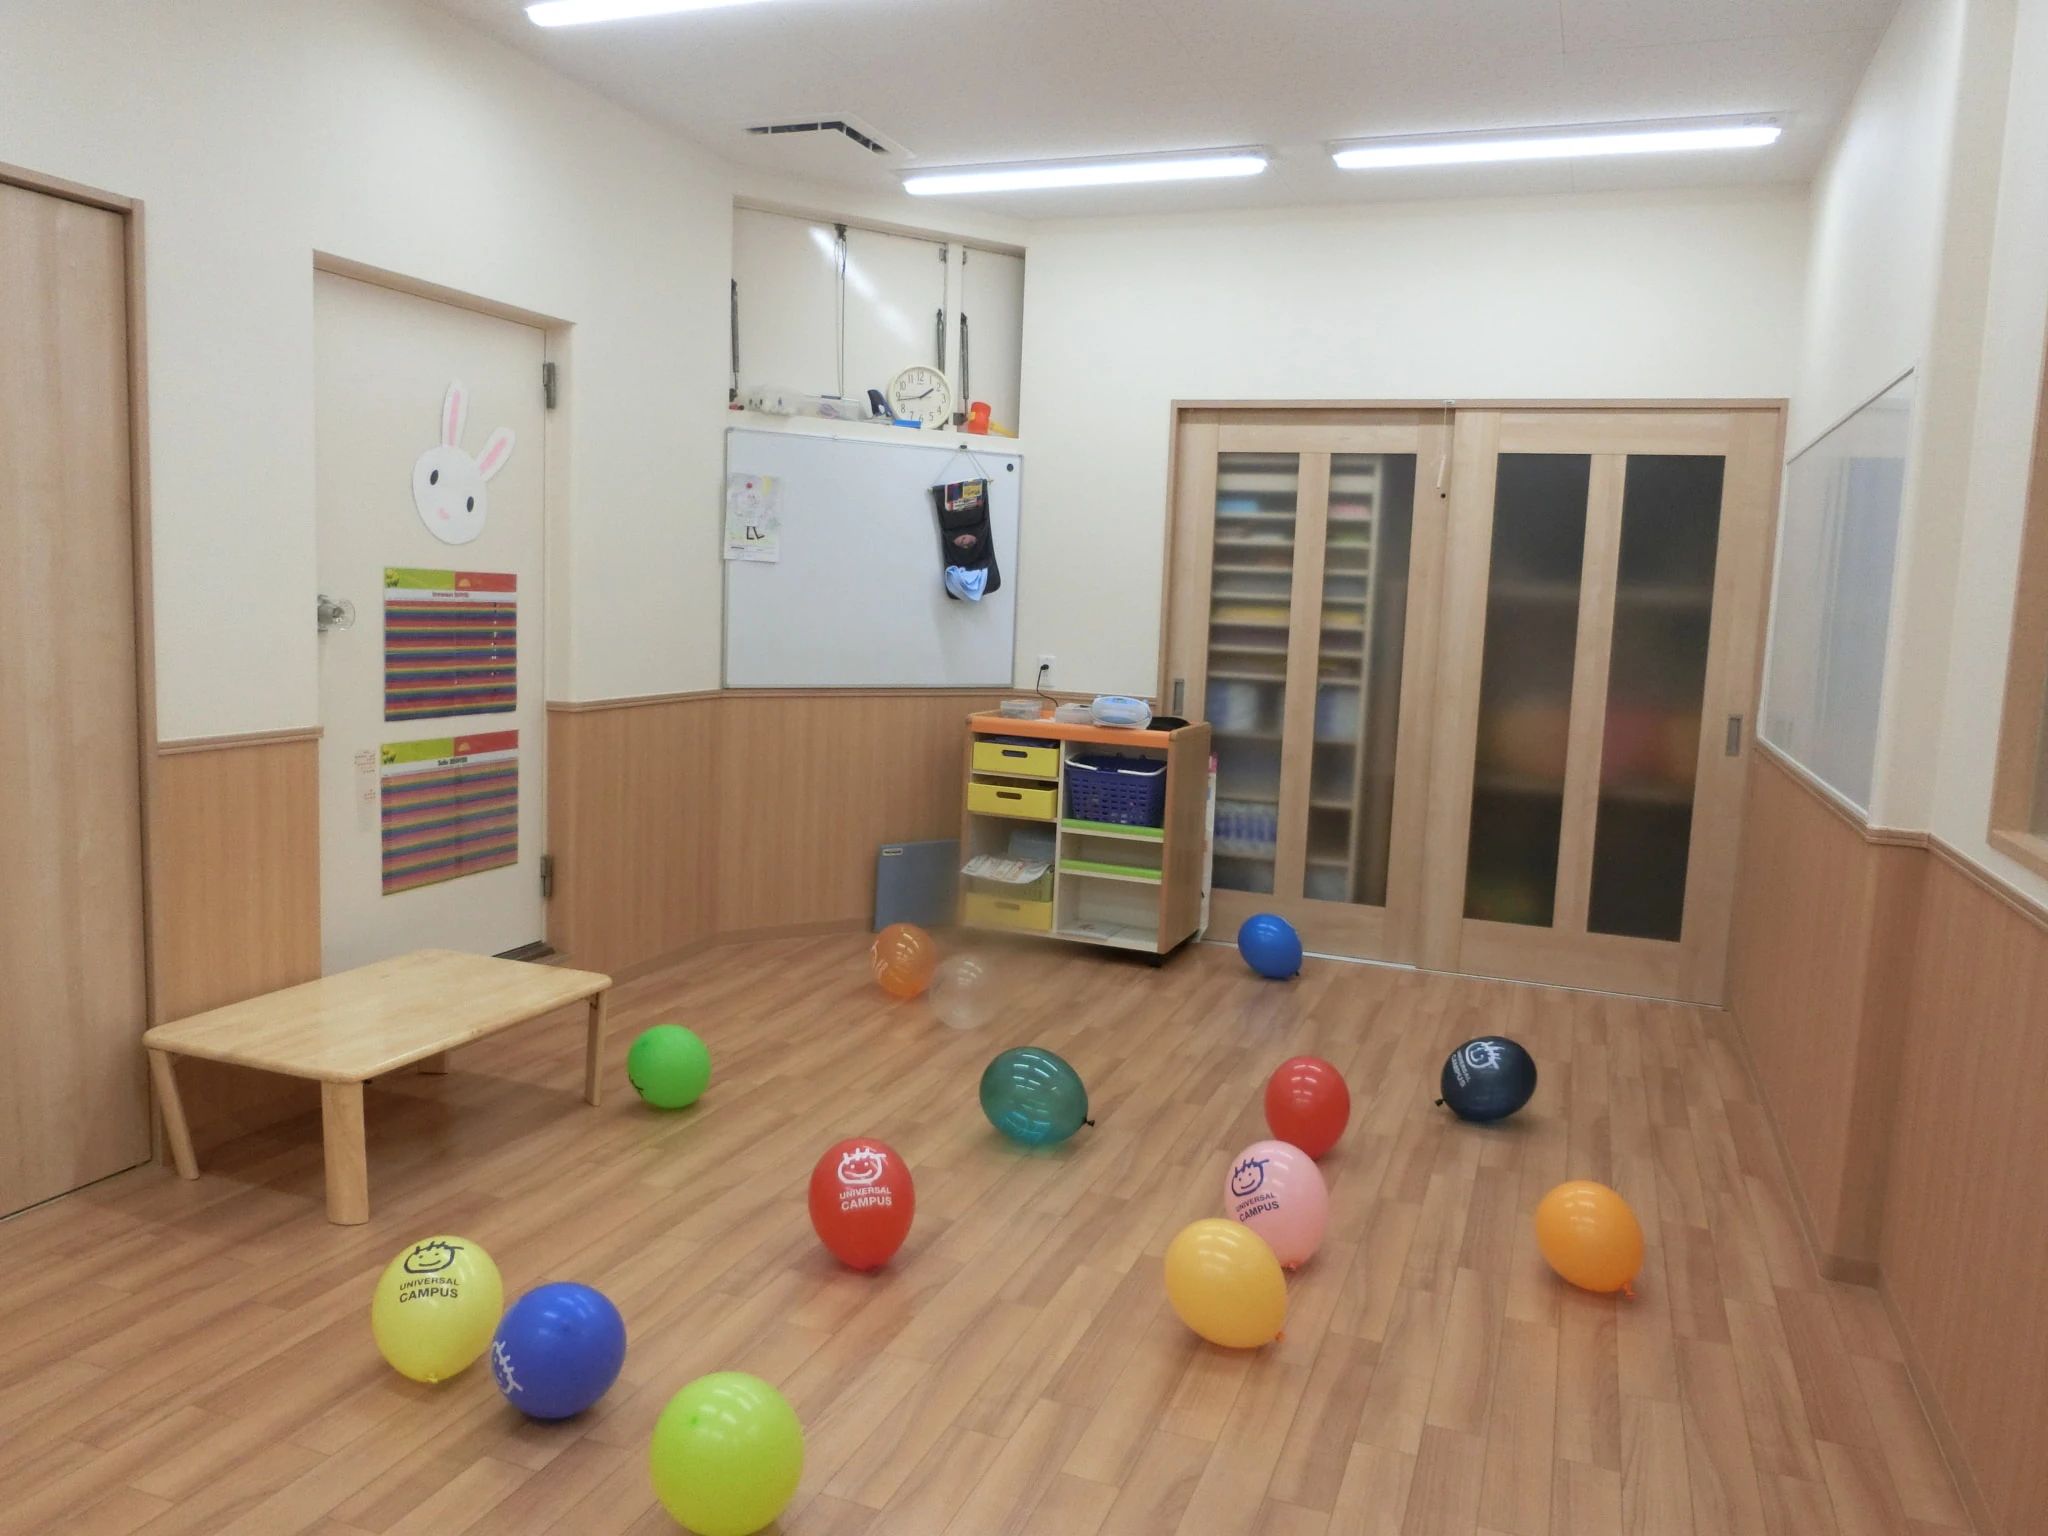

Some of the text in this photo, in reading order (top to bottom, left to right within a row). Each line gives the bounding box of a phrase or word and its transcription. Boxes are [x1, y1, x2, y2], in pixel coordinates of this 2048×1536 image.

[908, 373, 913, 384] 11
[917, 371, 924, 381] 12
[900, 381, 906, 391] 10
[936, 383, 941, 392] 2
[901, 404, 905, 413] 8
[937, 406, 942, 415] 4
[929, 411, 934, 421] 5
[840, 1187, 892, 1199] UNIVERSAL
[841, 1196, 892, 1211] CAMPUS
[1235, 1192, 1276, 1212] UNIVERSAL
[1239, 1201, 1279, 1222] CAMPUS
[400, 1277, 459, 1290] UNIVERSAL
[400, 1287, 458, 1303] CAMPUS
